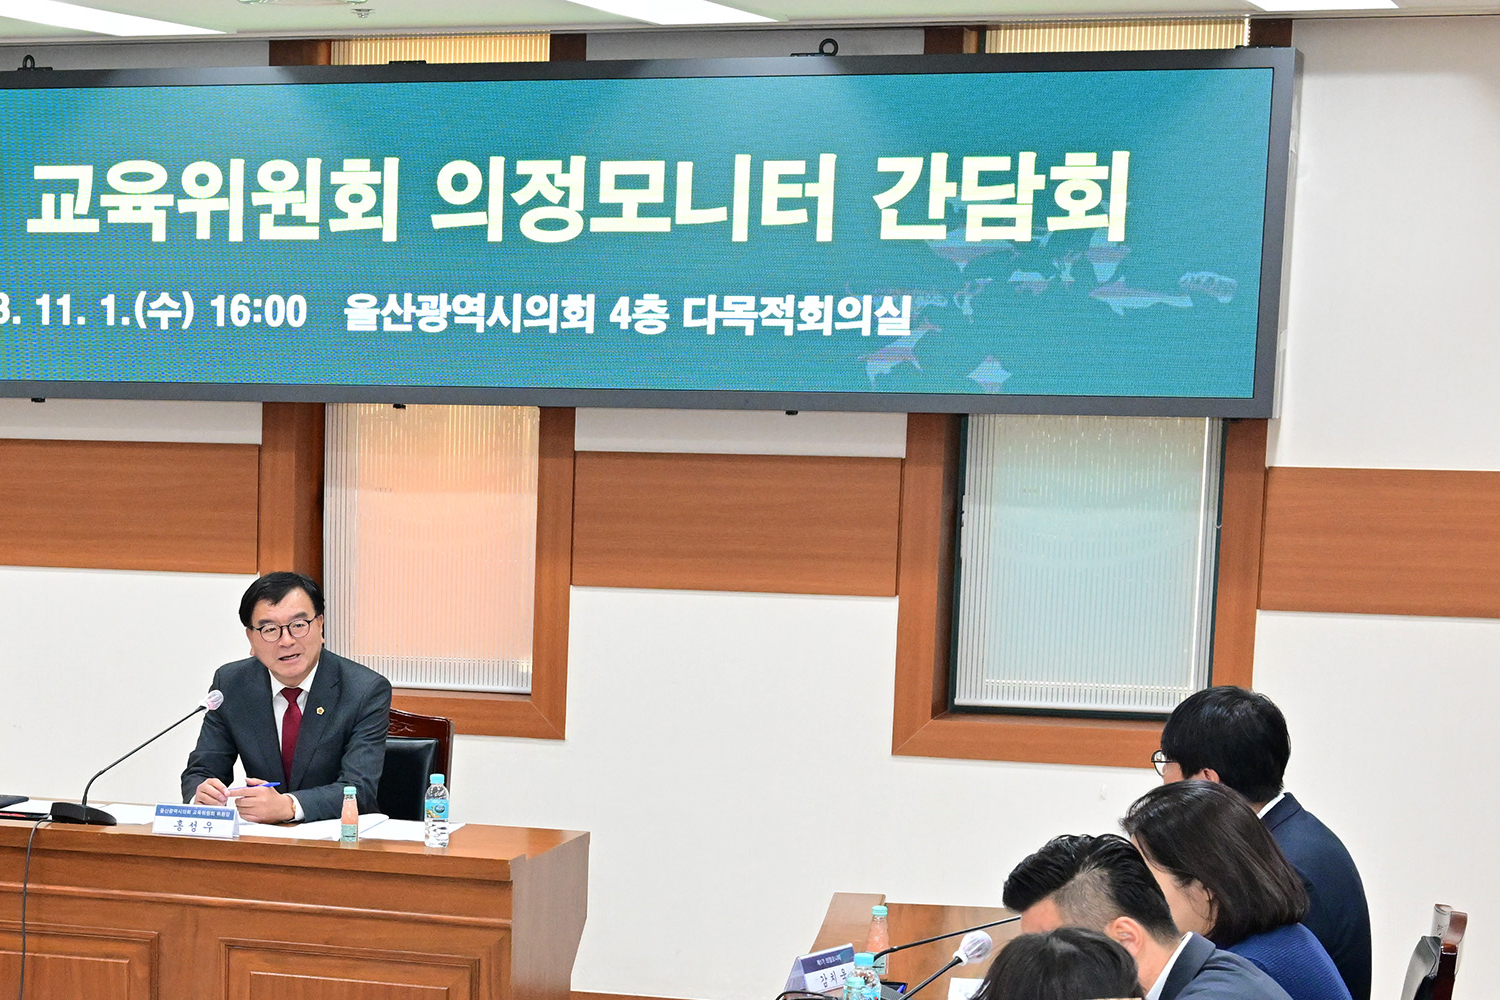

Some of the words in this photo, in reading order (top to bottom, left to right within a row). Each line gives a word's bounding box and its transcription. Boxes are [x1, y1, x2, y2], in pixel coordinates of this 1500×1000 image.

[26, 157, 400, 243] 교육위원회
[430, 153, 837, 243] 의정모니터
[872, 150, 1131, 242] 간담회
[35, 293, 86, 326] 11.
[100, 290, 194, 331] 1.(수)
[210, 294, 307, 328] 16:00
[343, 292, 596, 334] 울산광역시의회
[609, 293, 670, 335] 4층
[683, 294, 912, 337] 다목적회의실
